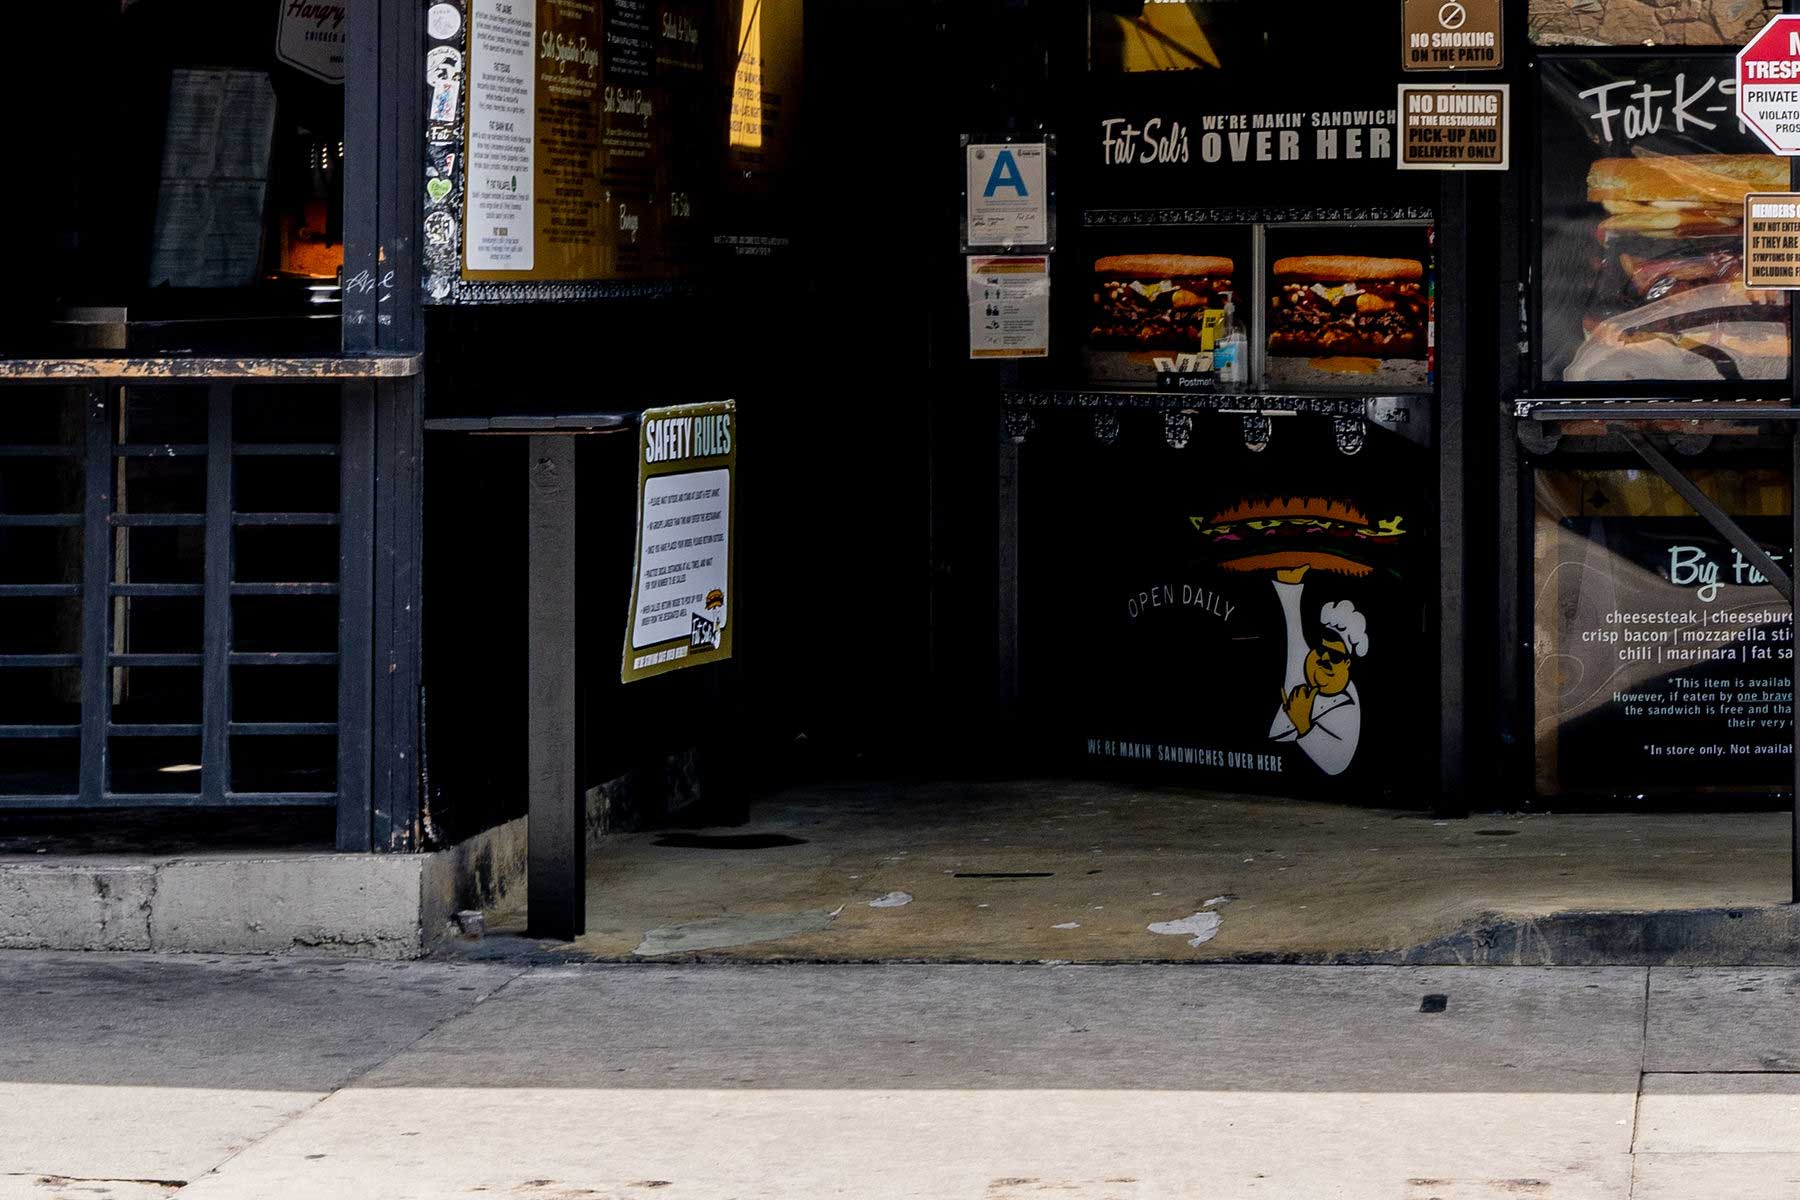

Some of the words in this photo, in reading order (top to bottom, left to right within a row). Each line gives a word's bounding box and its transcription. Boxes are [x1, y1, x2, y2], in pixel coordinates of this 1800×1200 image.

[1411, 33, 1429, 47] NO
[1432, 32, 1494, 47] SMOKING
[1411, 49, 1429, 62] ON
[1432, 49, 1455, 61] THE
[1459, 48, 1494, 61] PATIO
[1748, 91, 1798, 102] PRIVATE
[1409, 95, 1433, 113] NO
[1437, 95, 1497, 113] DINING
[1578, 80, 1672, 142] Fat
[1202, 115, 1247, 130] WE'RE
[1252, 113, 1306, 128] MAKIN'
[1311, 110, 1396, 126] SANDWICH
[1409, 116, 1419, 126] IN
[1421, 116, 1438, 126] THE
[1439, 116, 1497, 126] RESTAURANT
[1102, 118, 1140, 165] Fat
[1140, 118, 1189, 164] Sal's
[1409, 128, 1466, 142] PICK-UP
[1469, 128, 1496, 142] AND
[1202, 131, 1299, 162] OVER
[1316, 128, 1391, 160] HER
[1409, 146, 1464, 158] DELIVERY
[1468, 146, 1496, 158] ONLY
[984, 151, 1028, 197] A
[1752, 204, 1795, 218] MEMBERS
[1768, 222, 1780, 231] NOT
[1762, 237, 1780, 248] THEY
[1783, 237, 1798, 248] ARE
[1753, 253, 1785, 262] SYMPTOMS
[1752, 267, 1793, 277] INCLUDING
[646, 417, 691, 463] SAFETY
[694, 414, 731, 456] RULES
[1668, 546, 1725, 602] Big
[1128, 584, 1174, 617] OPEN
[1182, 584, 1235, 622] DAILY
[1606, 610, 1697, 624] cheesesteak
[1582, 629, 1618, 644] crisp
[1625, 629, 1667, 642] bacon
[1683, 629, 1766, 642] mozzarella
[1619, 647, 1651, 660] chili
[1667, 647, 1736, 660] marinara
[1752, 646, 1772, 659] fat
[1704, 677, 1730, 688] item
[1613, 692, 1665, 703] However,
[1683, 692, 1715, 702] eaten
[1762, 692, 1793, 702] brave
[1648, 705, 1700, 715] sandwich
[1720, 705, 1744, 714] free
[1728, 718, 1756, 728] their
[1666, 745, 1695, 755] store
[1699, 744, 1726, 757] only.
[1730, 745, 1750, 754] Not
[1158, 744, 1225, 767] SANDWICHES
[1227, 751, 1254, 769] OVER
[1257, 754, 1283, 772] HERE
